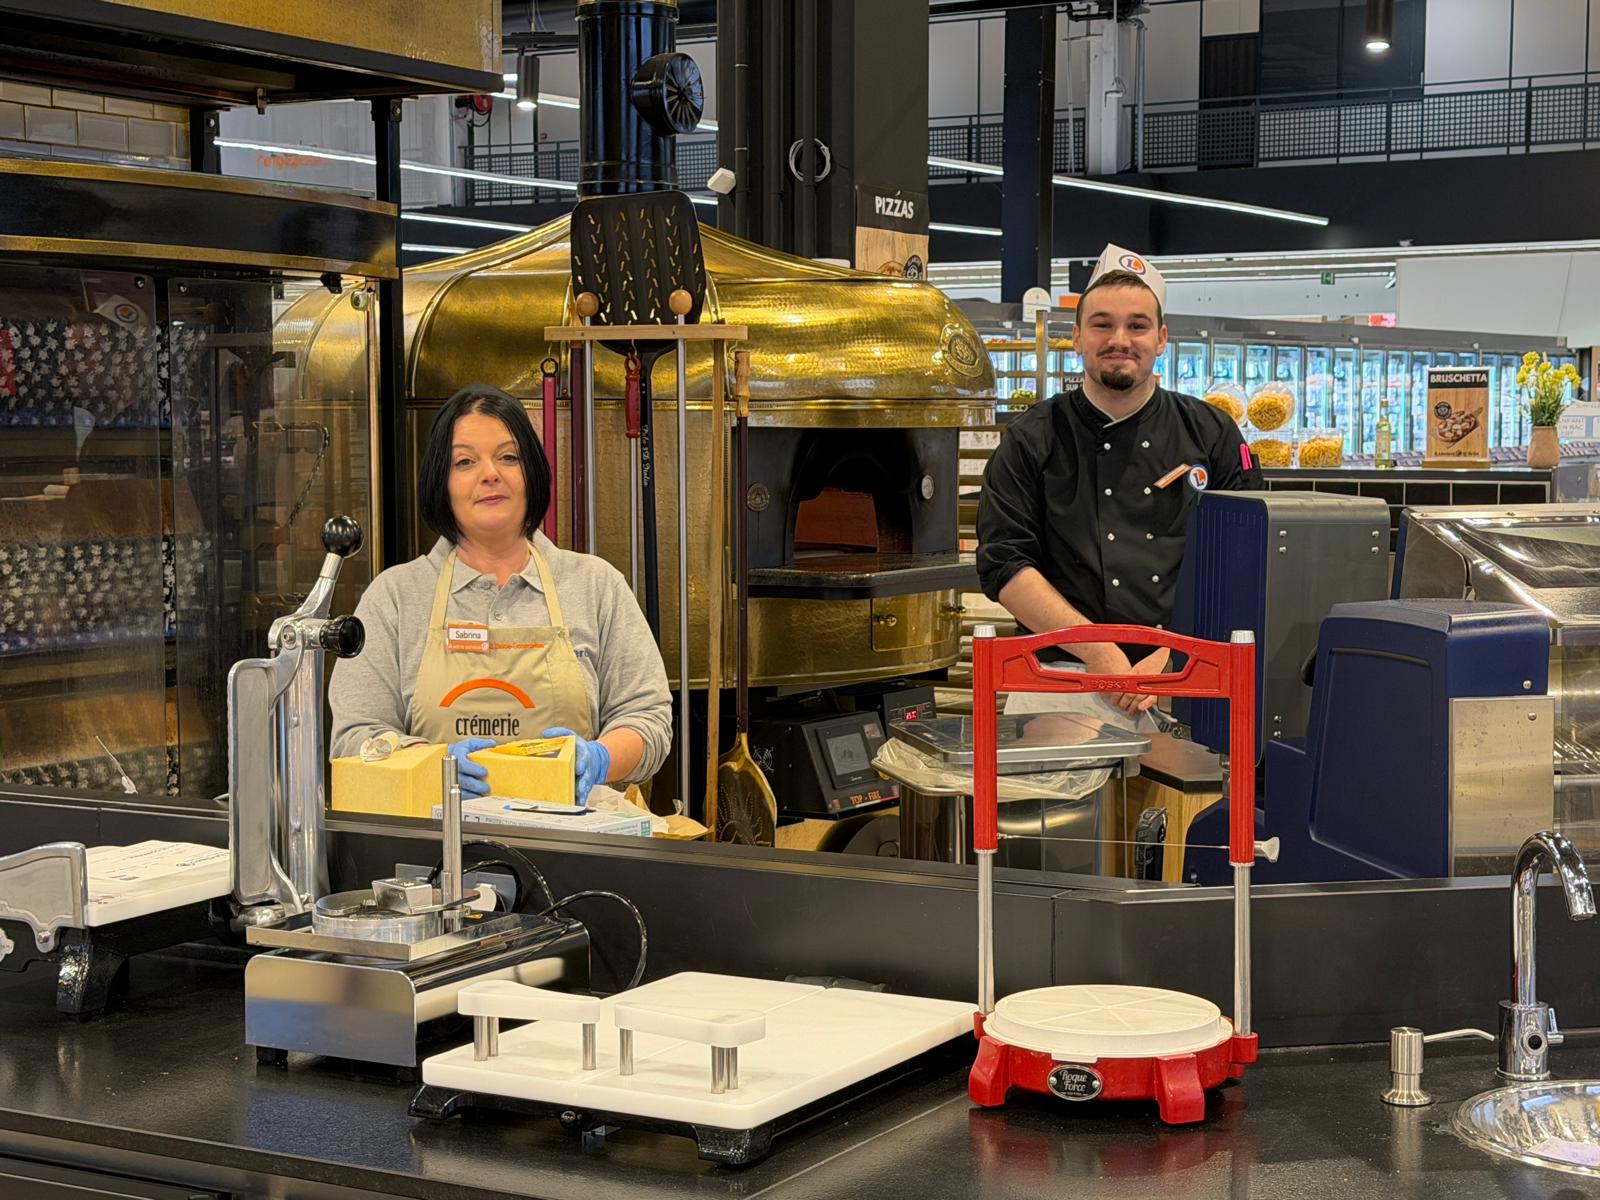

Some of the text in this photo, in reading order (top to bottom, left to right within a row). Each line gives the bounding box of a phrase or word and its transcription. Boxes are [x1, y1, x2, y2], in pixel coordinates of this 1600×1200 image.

[875, 191, 914, 219] PIZZAS
[1430, 373, 1487, 383] BRUSCHETTA
[455, 630, 481, 639] Sabrina
[1091, 680, 1129, 689] BOSKA
[455, 713, 520, 736] crémerie
[850, 794, 864, 805] TOP
